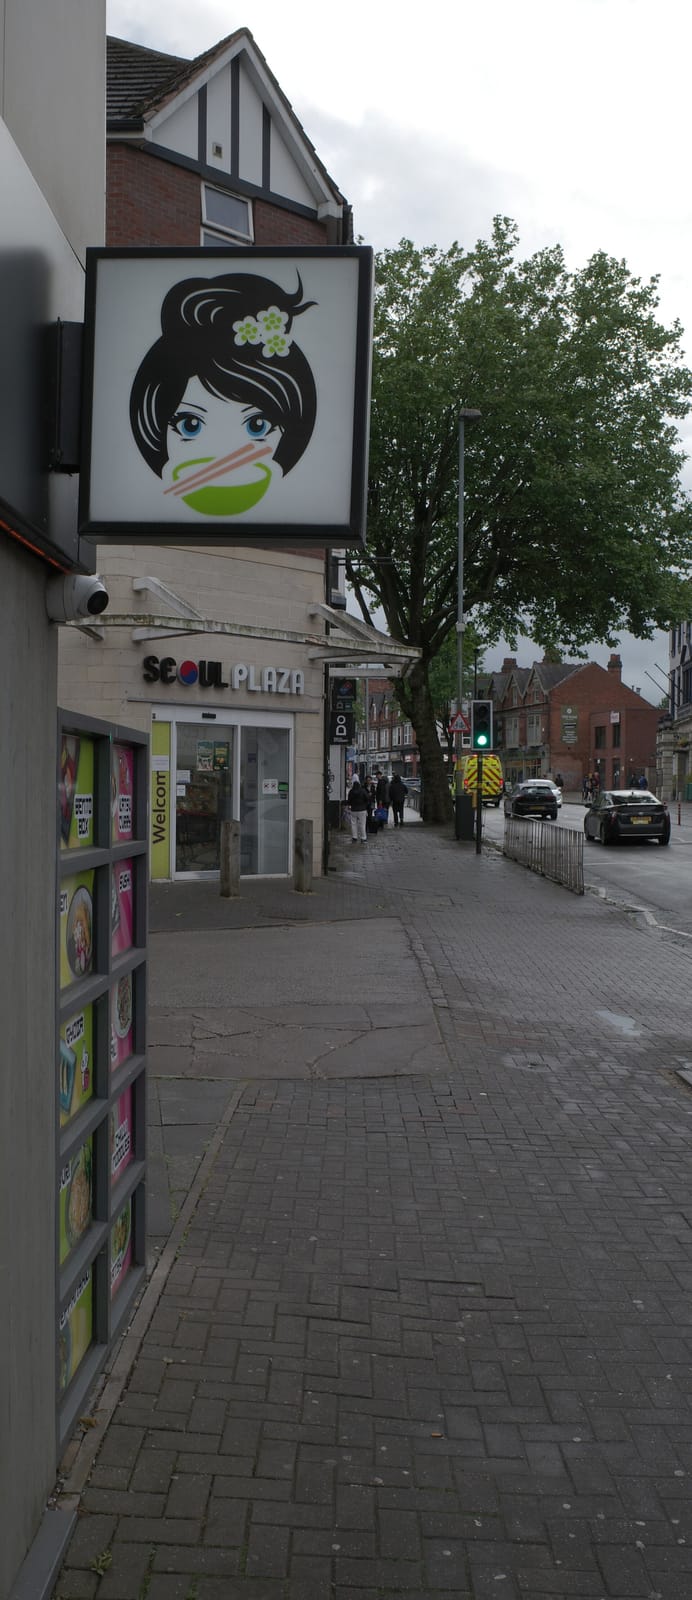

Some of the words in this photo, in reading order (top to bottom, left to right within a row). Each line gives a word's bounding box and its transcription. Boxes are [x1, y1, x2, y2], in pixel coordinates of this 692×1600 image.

[143, 655, 229, 689] SEOUL
[231, 663, 305, 695] PLAZA
[335, 715, 347, 736] DO
[152, 771, 166, 844] Welcom
[78, 818, 89, 835] BOX
